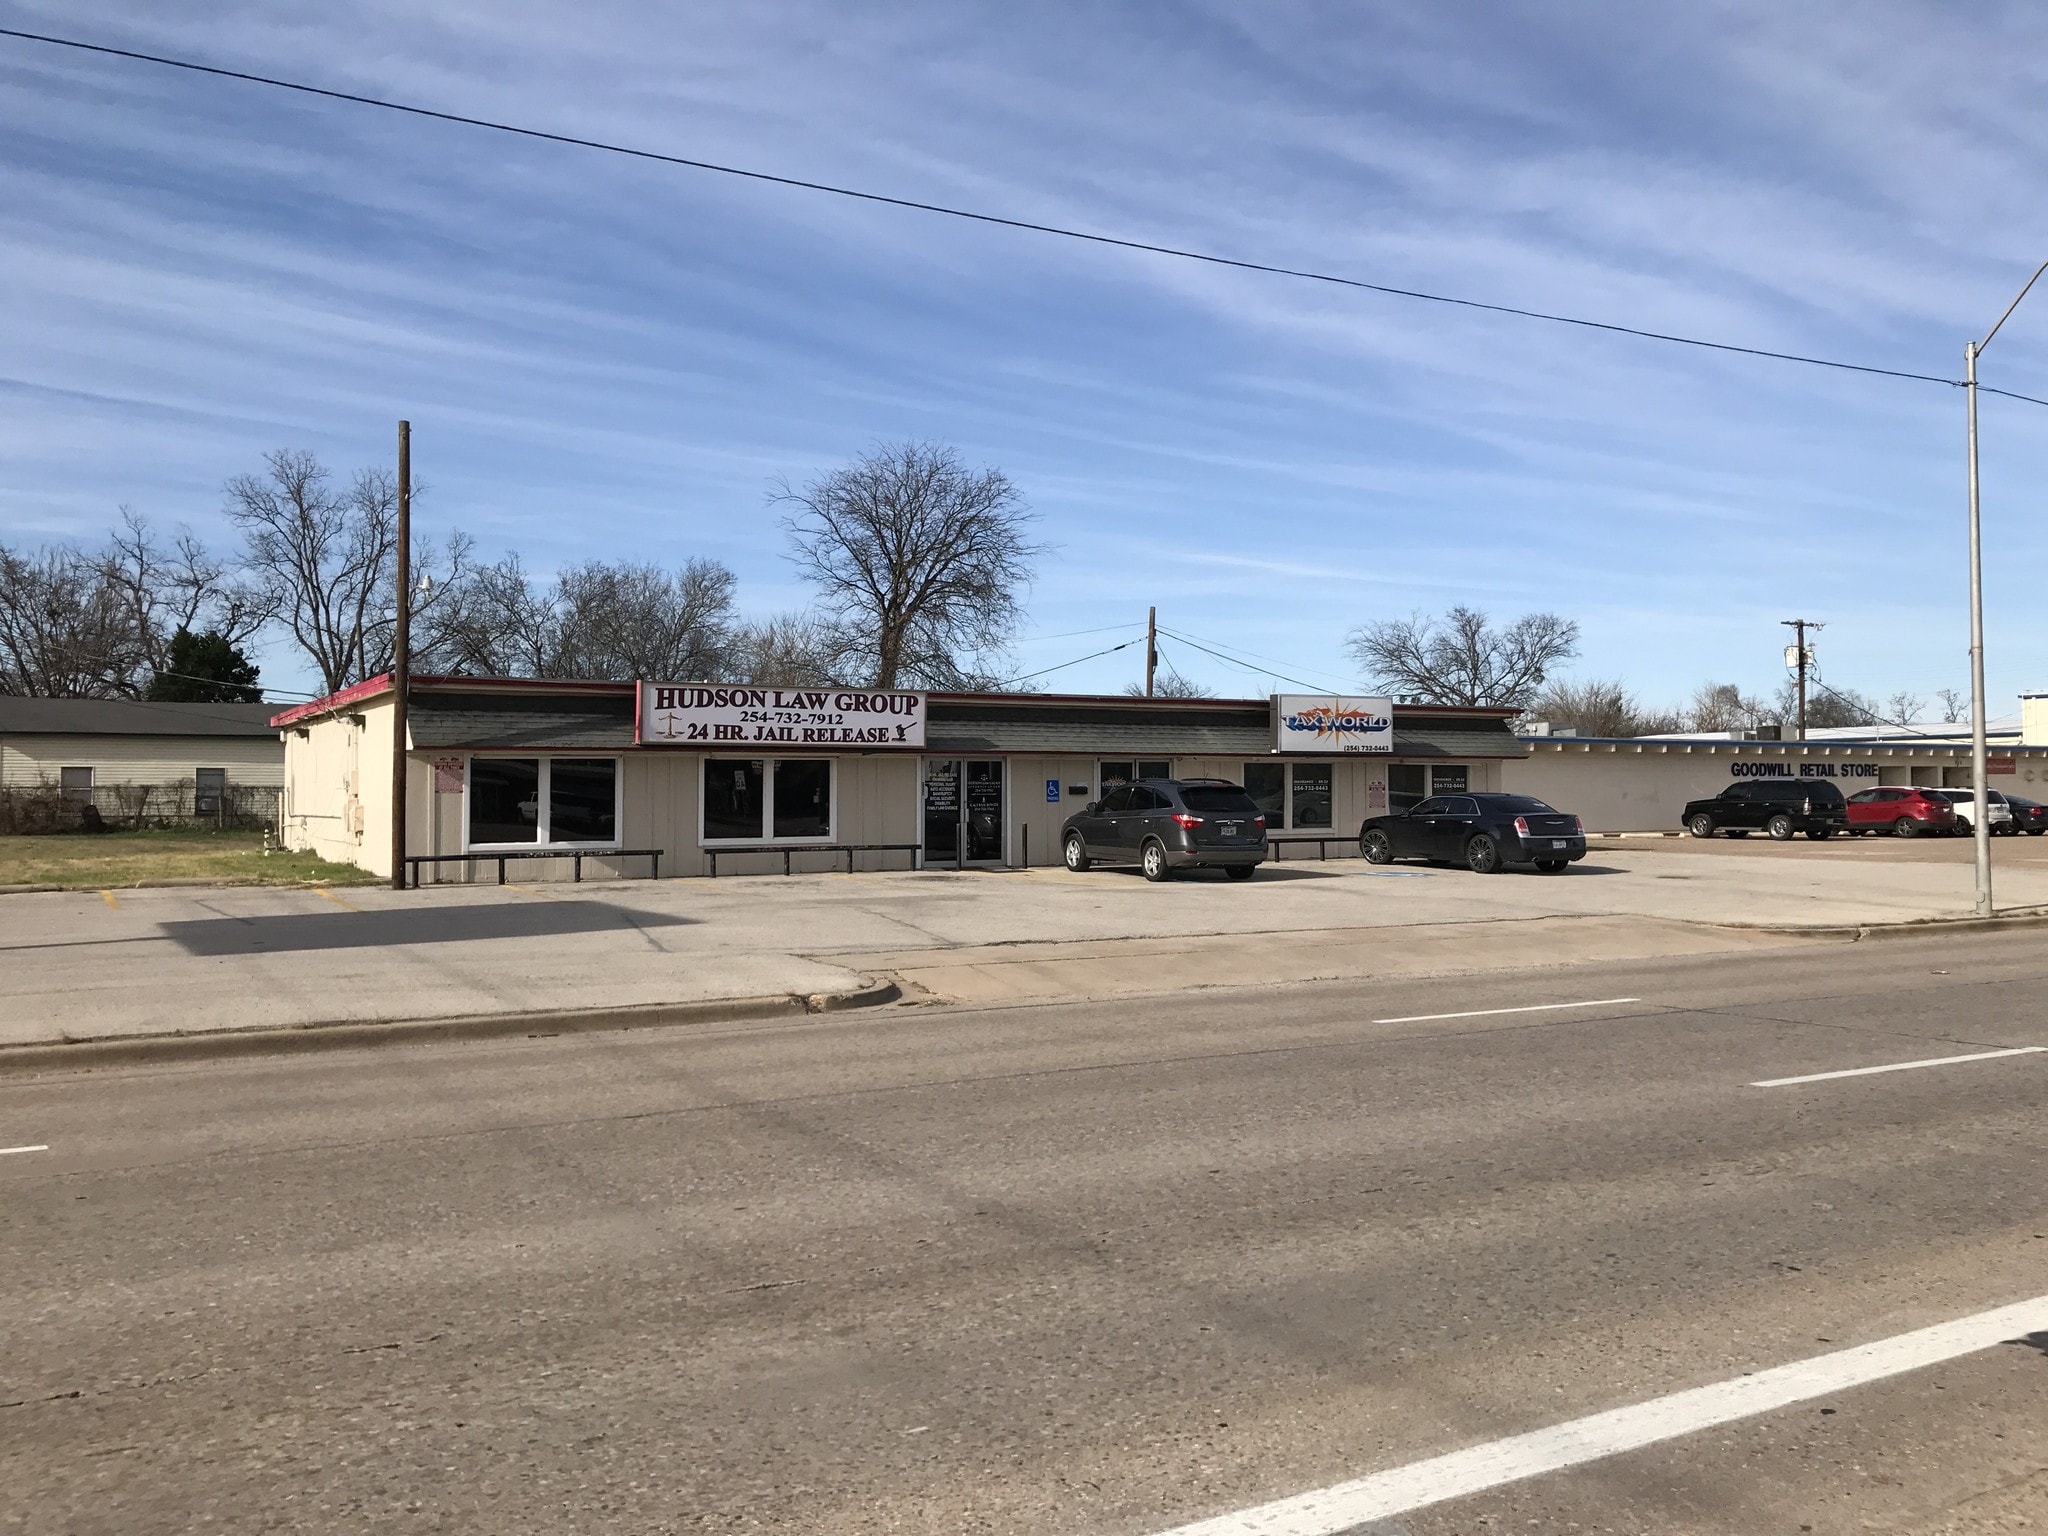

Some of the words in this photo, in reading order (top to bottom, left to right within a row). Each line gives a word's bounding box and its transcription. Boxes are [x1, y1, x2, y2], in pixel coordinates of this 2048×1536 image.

[654, 687, 767, 711] HUDSON
[772, 691, 830, 711] LAW
[834, 693, 919, 716] GROUP
[740, 710, 843, 725] 254-732-7912
[1282, 715, 1321, 730] TAX
[1324, 716, 1392, 731] WORLD
[687, 722, 709, 740] 24
[713, 724, 749, 741] HR.
[753, 725, 799, 742] JAIL
[801, 727, 890, 743] RELEASE
[1731, 762, 1795, 777] GOODWILL
[1800, 763, 1838, 777] RETAIL
[1840, 763, 1879, 777] STORE
